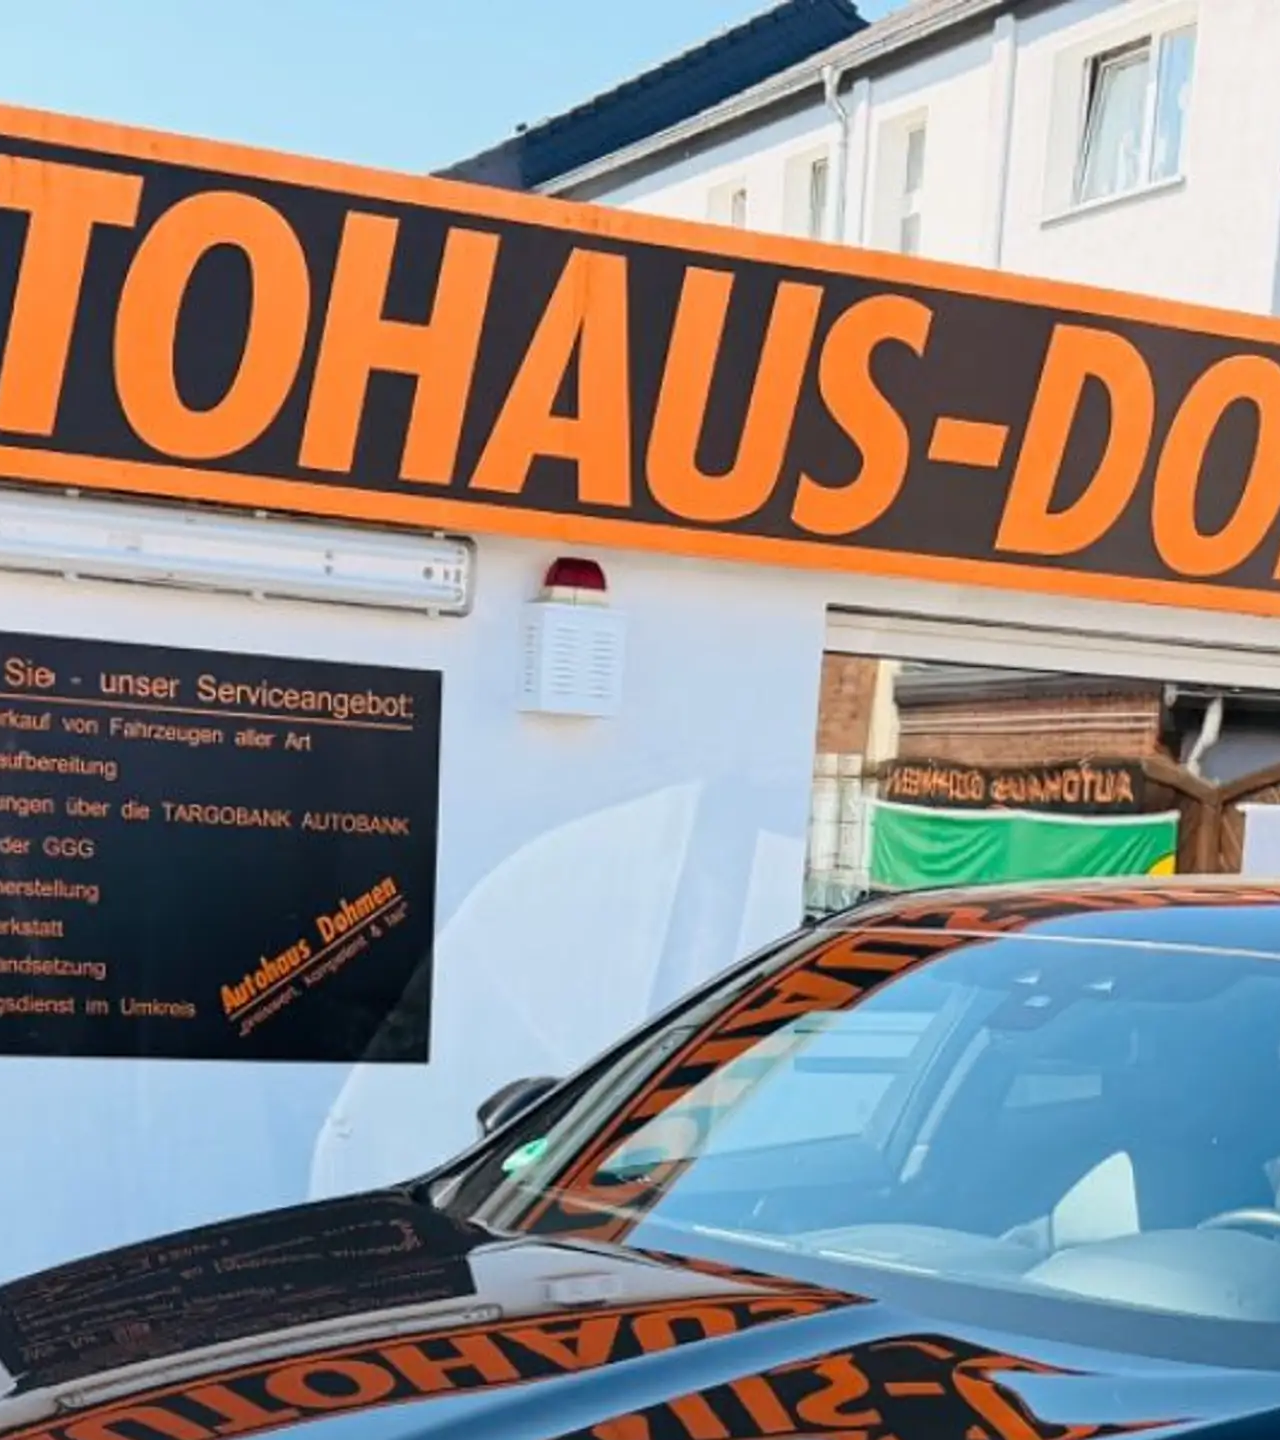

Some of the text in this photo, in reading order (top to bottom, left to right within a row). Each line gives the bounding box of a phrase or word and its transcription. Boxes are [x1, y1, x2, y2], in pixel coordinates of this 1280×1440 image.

[5, 657, 56, 688] Sie
[100, 671, 180, 698] unser
[197, 674, 414, 720] Serviceangebot:
[62, 717, 99, 735] von
[109, 717, 224, 747] Fahrzeugen
[234, 729, 275, 748] aller
[284, 731, 311, 751] Art
[65, 795, 111, 818] über
[121, 799, 150, 820] die
[162, 802, 292, 828] TARGOBANK
[301, 810, 410, 835] AUTOBANK
[42, 836, 95, 859] GGG
[221, 876, 397, 1015] Autohaus Dohmen
[85, 997, 109, 1015] im
[120, 1000, 196, 1019] Umkreis
